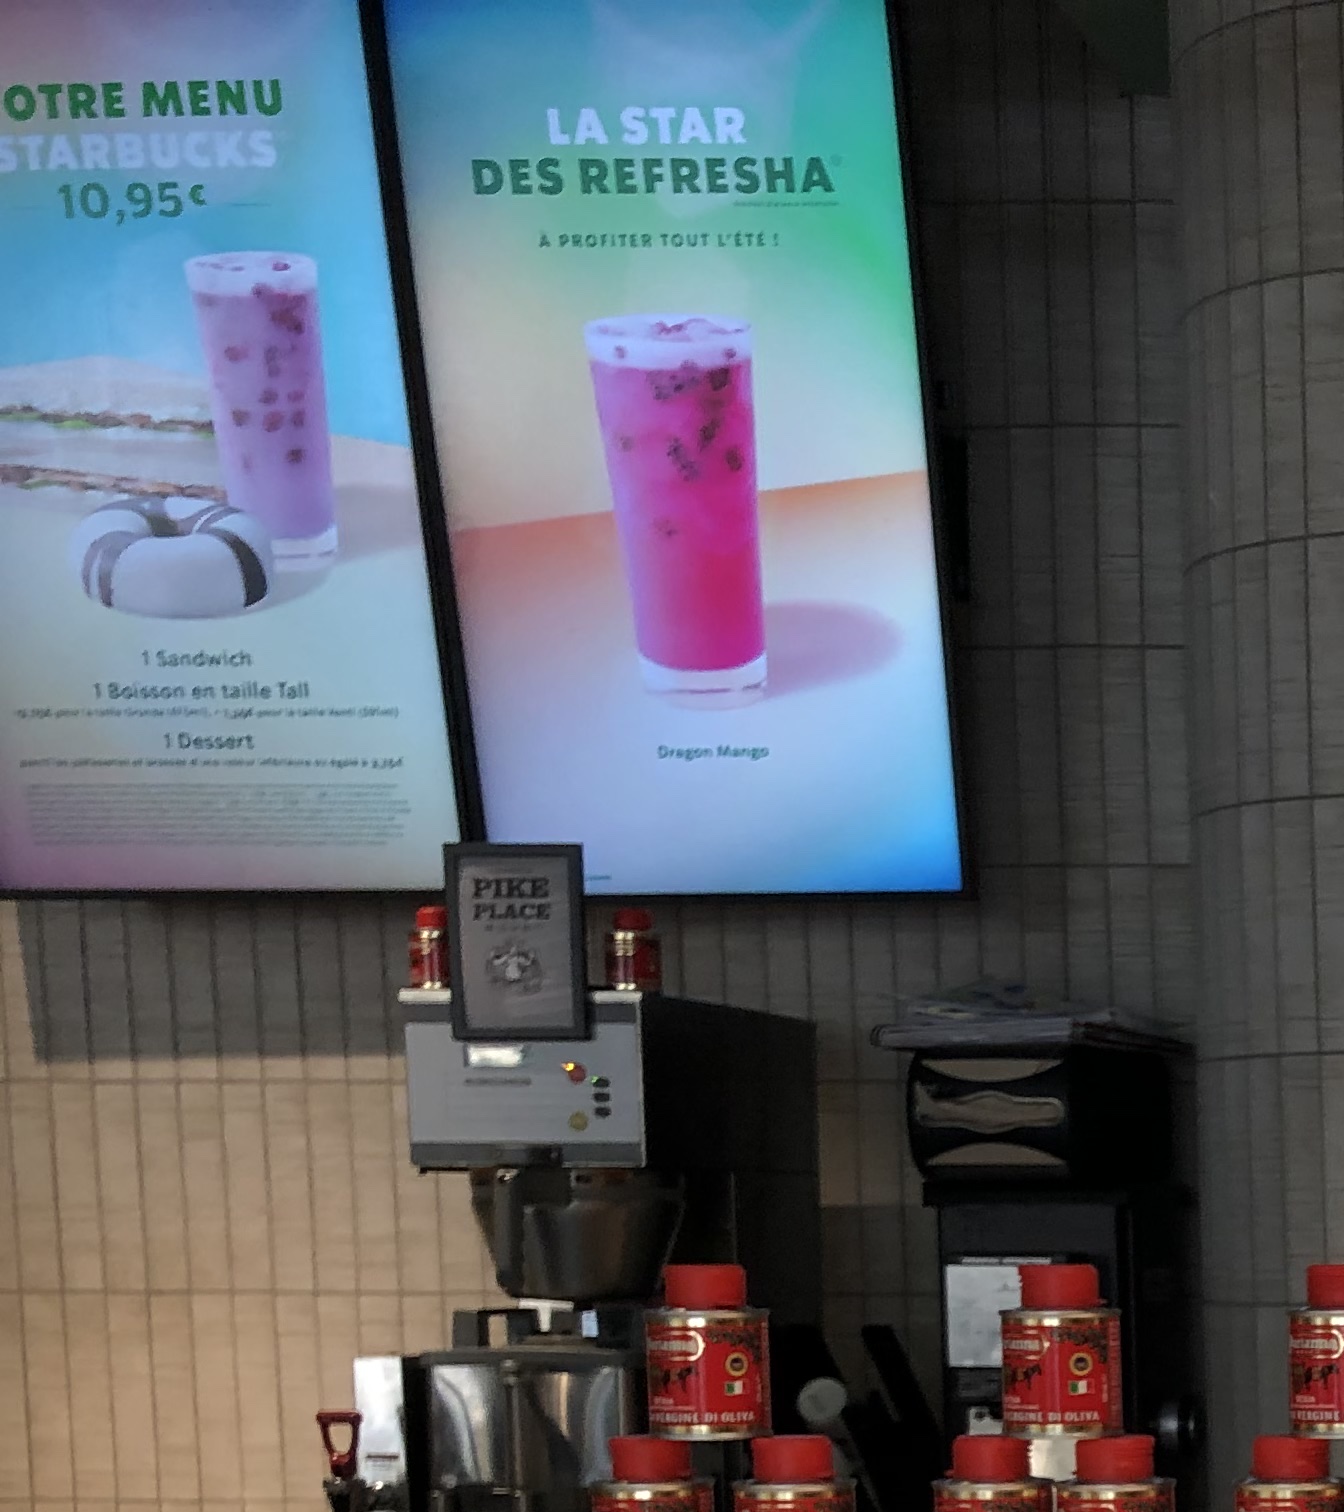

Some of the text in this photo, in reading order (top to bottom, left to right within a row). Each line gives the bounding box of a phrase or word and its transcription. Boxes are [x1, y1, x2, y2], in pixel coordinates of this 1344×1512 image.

[142, 79, 282, 119] MENU
[547, 106, 747, 146] LA STAR
[0, 131, 278, 173] STARBUCKS
[471, 156, 835, 196] DES REFRESHA
[58, 182, 207, 226] 10,95€
[558, 232, 652, 249] PROFITER
[660, 232, 709, 248] TOUT
[156, 649, 254, 667] Sandwich
[108, 681, 185, 700] Boisson
[192, 685, 215, 699] en
[221, 681, 272, 699] taille
[278, 681, 310, 698] Tall
[178, 732, 255, 750] Dessert
[657, 744, 770, 762] Dragon Mango
[473, 877, 550, 900] PIKE
[474, 903, 550, 921] PLACE
